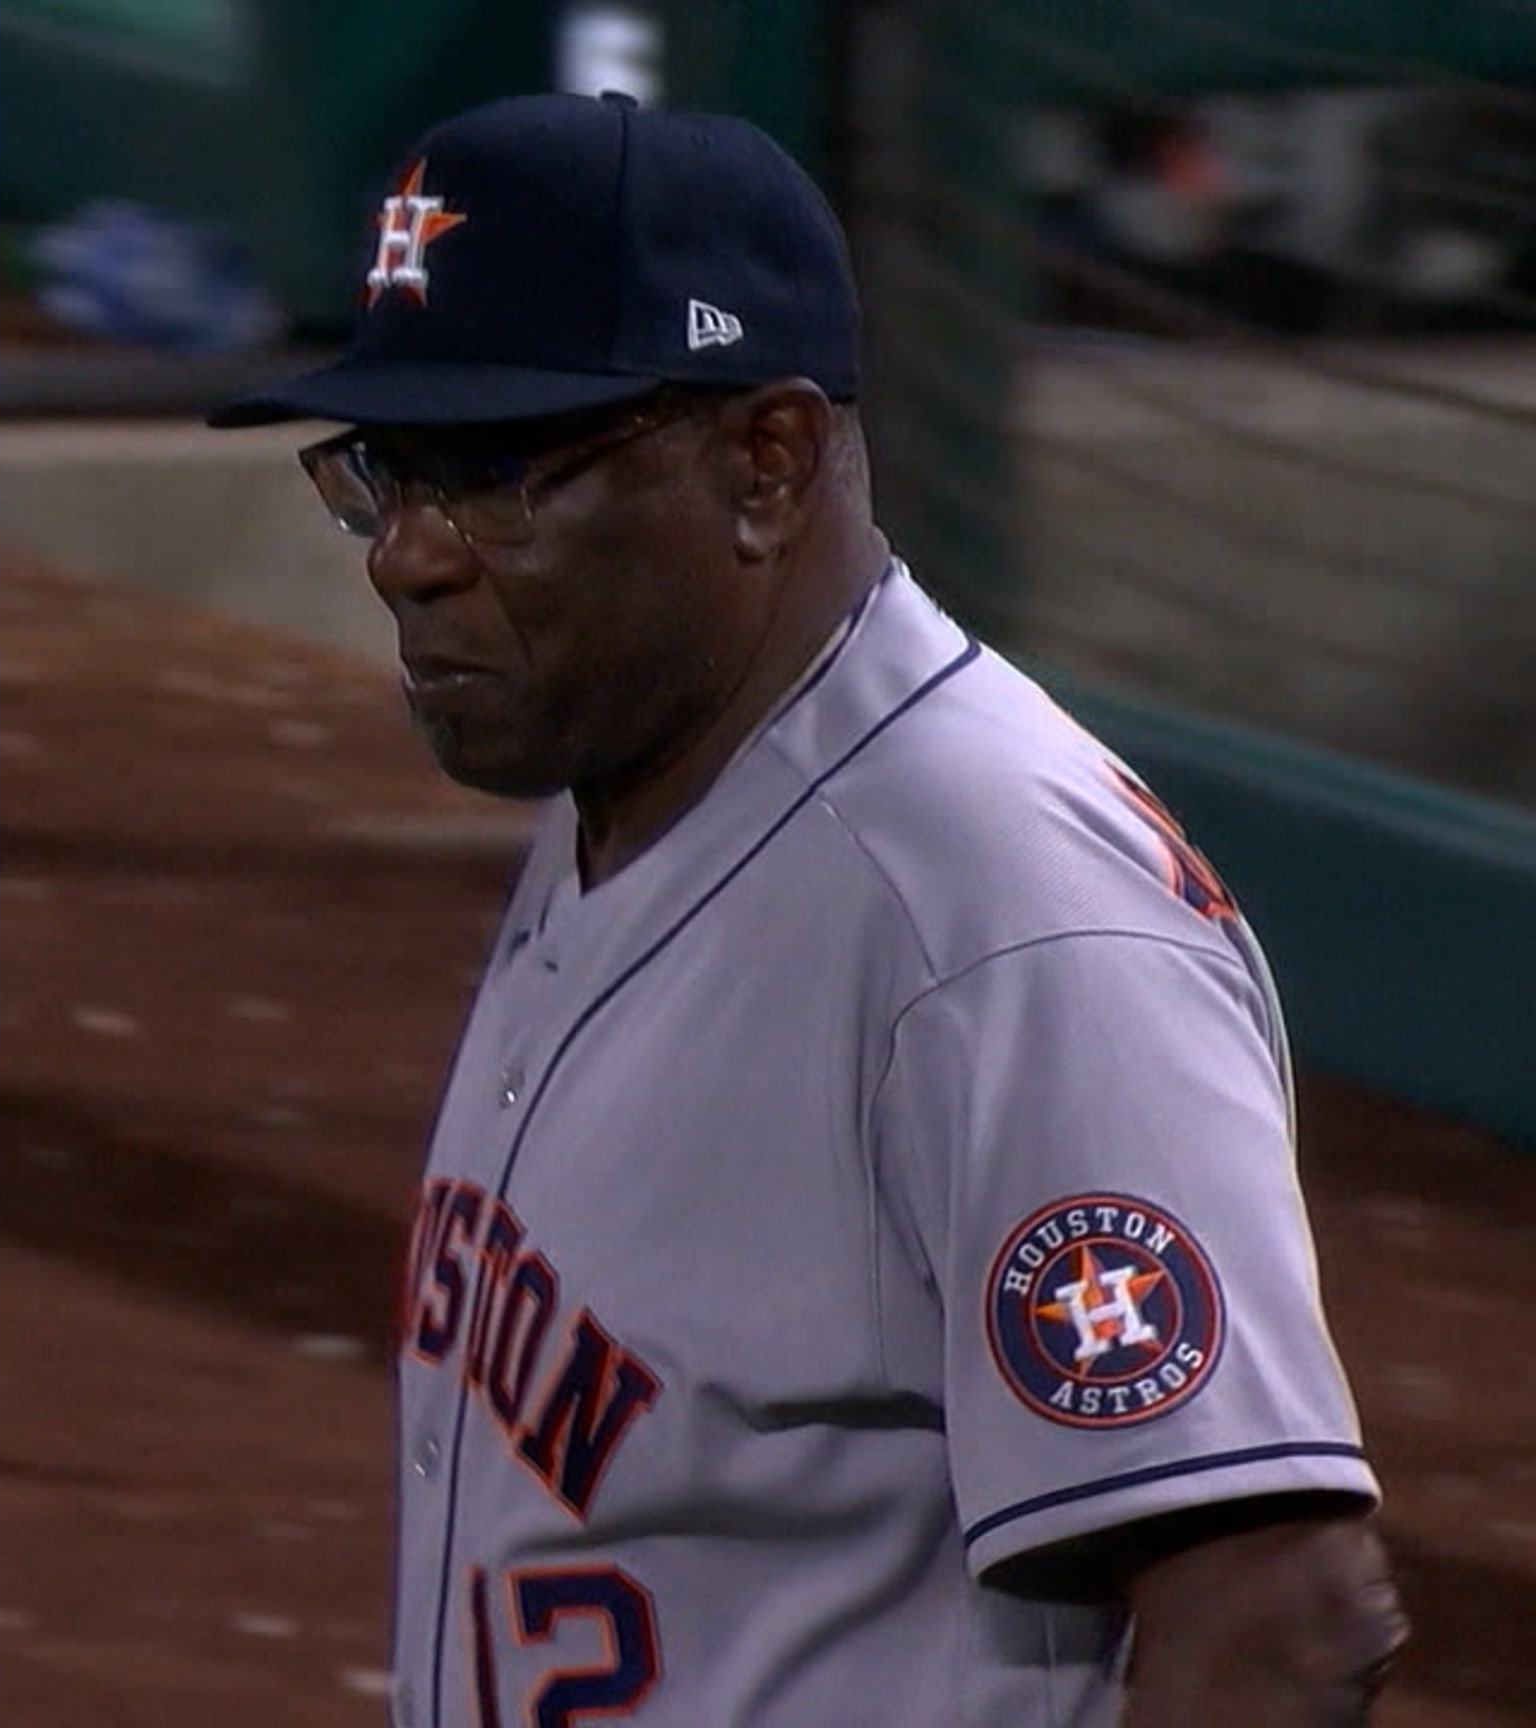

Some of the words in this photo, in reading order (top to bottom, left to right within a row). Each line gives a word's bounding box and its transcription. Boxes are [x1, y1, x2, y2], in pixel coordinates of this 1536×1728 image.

[366, 196, 444, 288] H
[1003, 1206, 1175, 1297] HOUSTON
[1053, 1264, 1158, 1360] H
[1049, 1342, 1205, 1415] ASTROS
